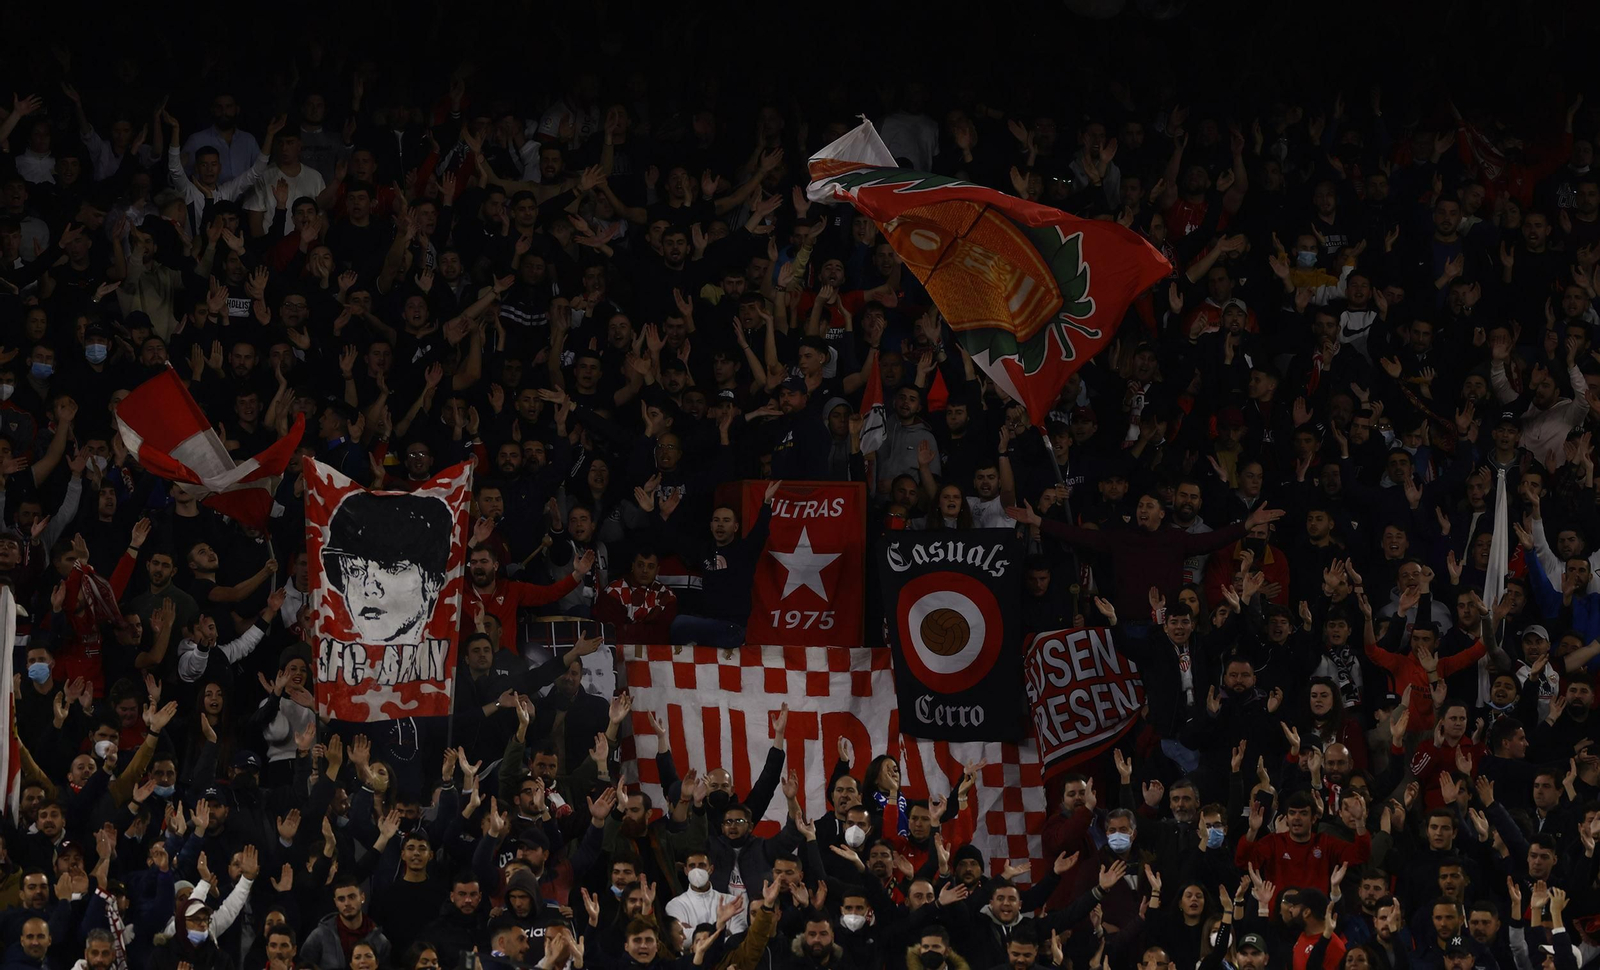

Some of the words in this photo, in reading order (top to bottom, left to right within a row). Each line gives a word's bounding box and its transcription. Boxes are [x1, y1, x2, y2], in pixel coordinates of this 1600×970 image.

[771, 498, 845, 519] ULTRAS
[887, 541, 1012, 578] Casuals
[771, 609, 836, 630] 1975
[915, 694, 985, 727] Cerro
